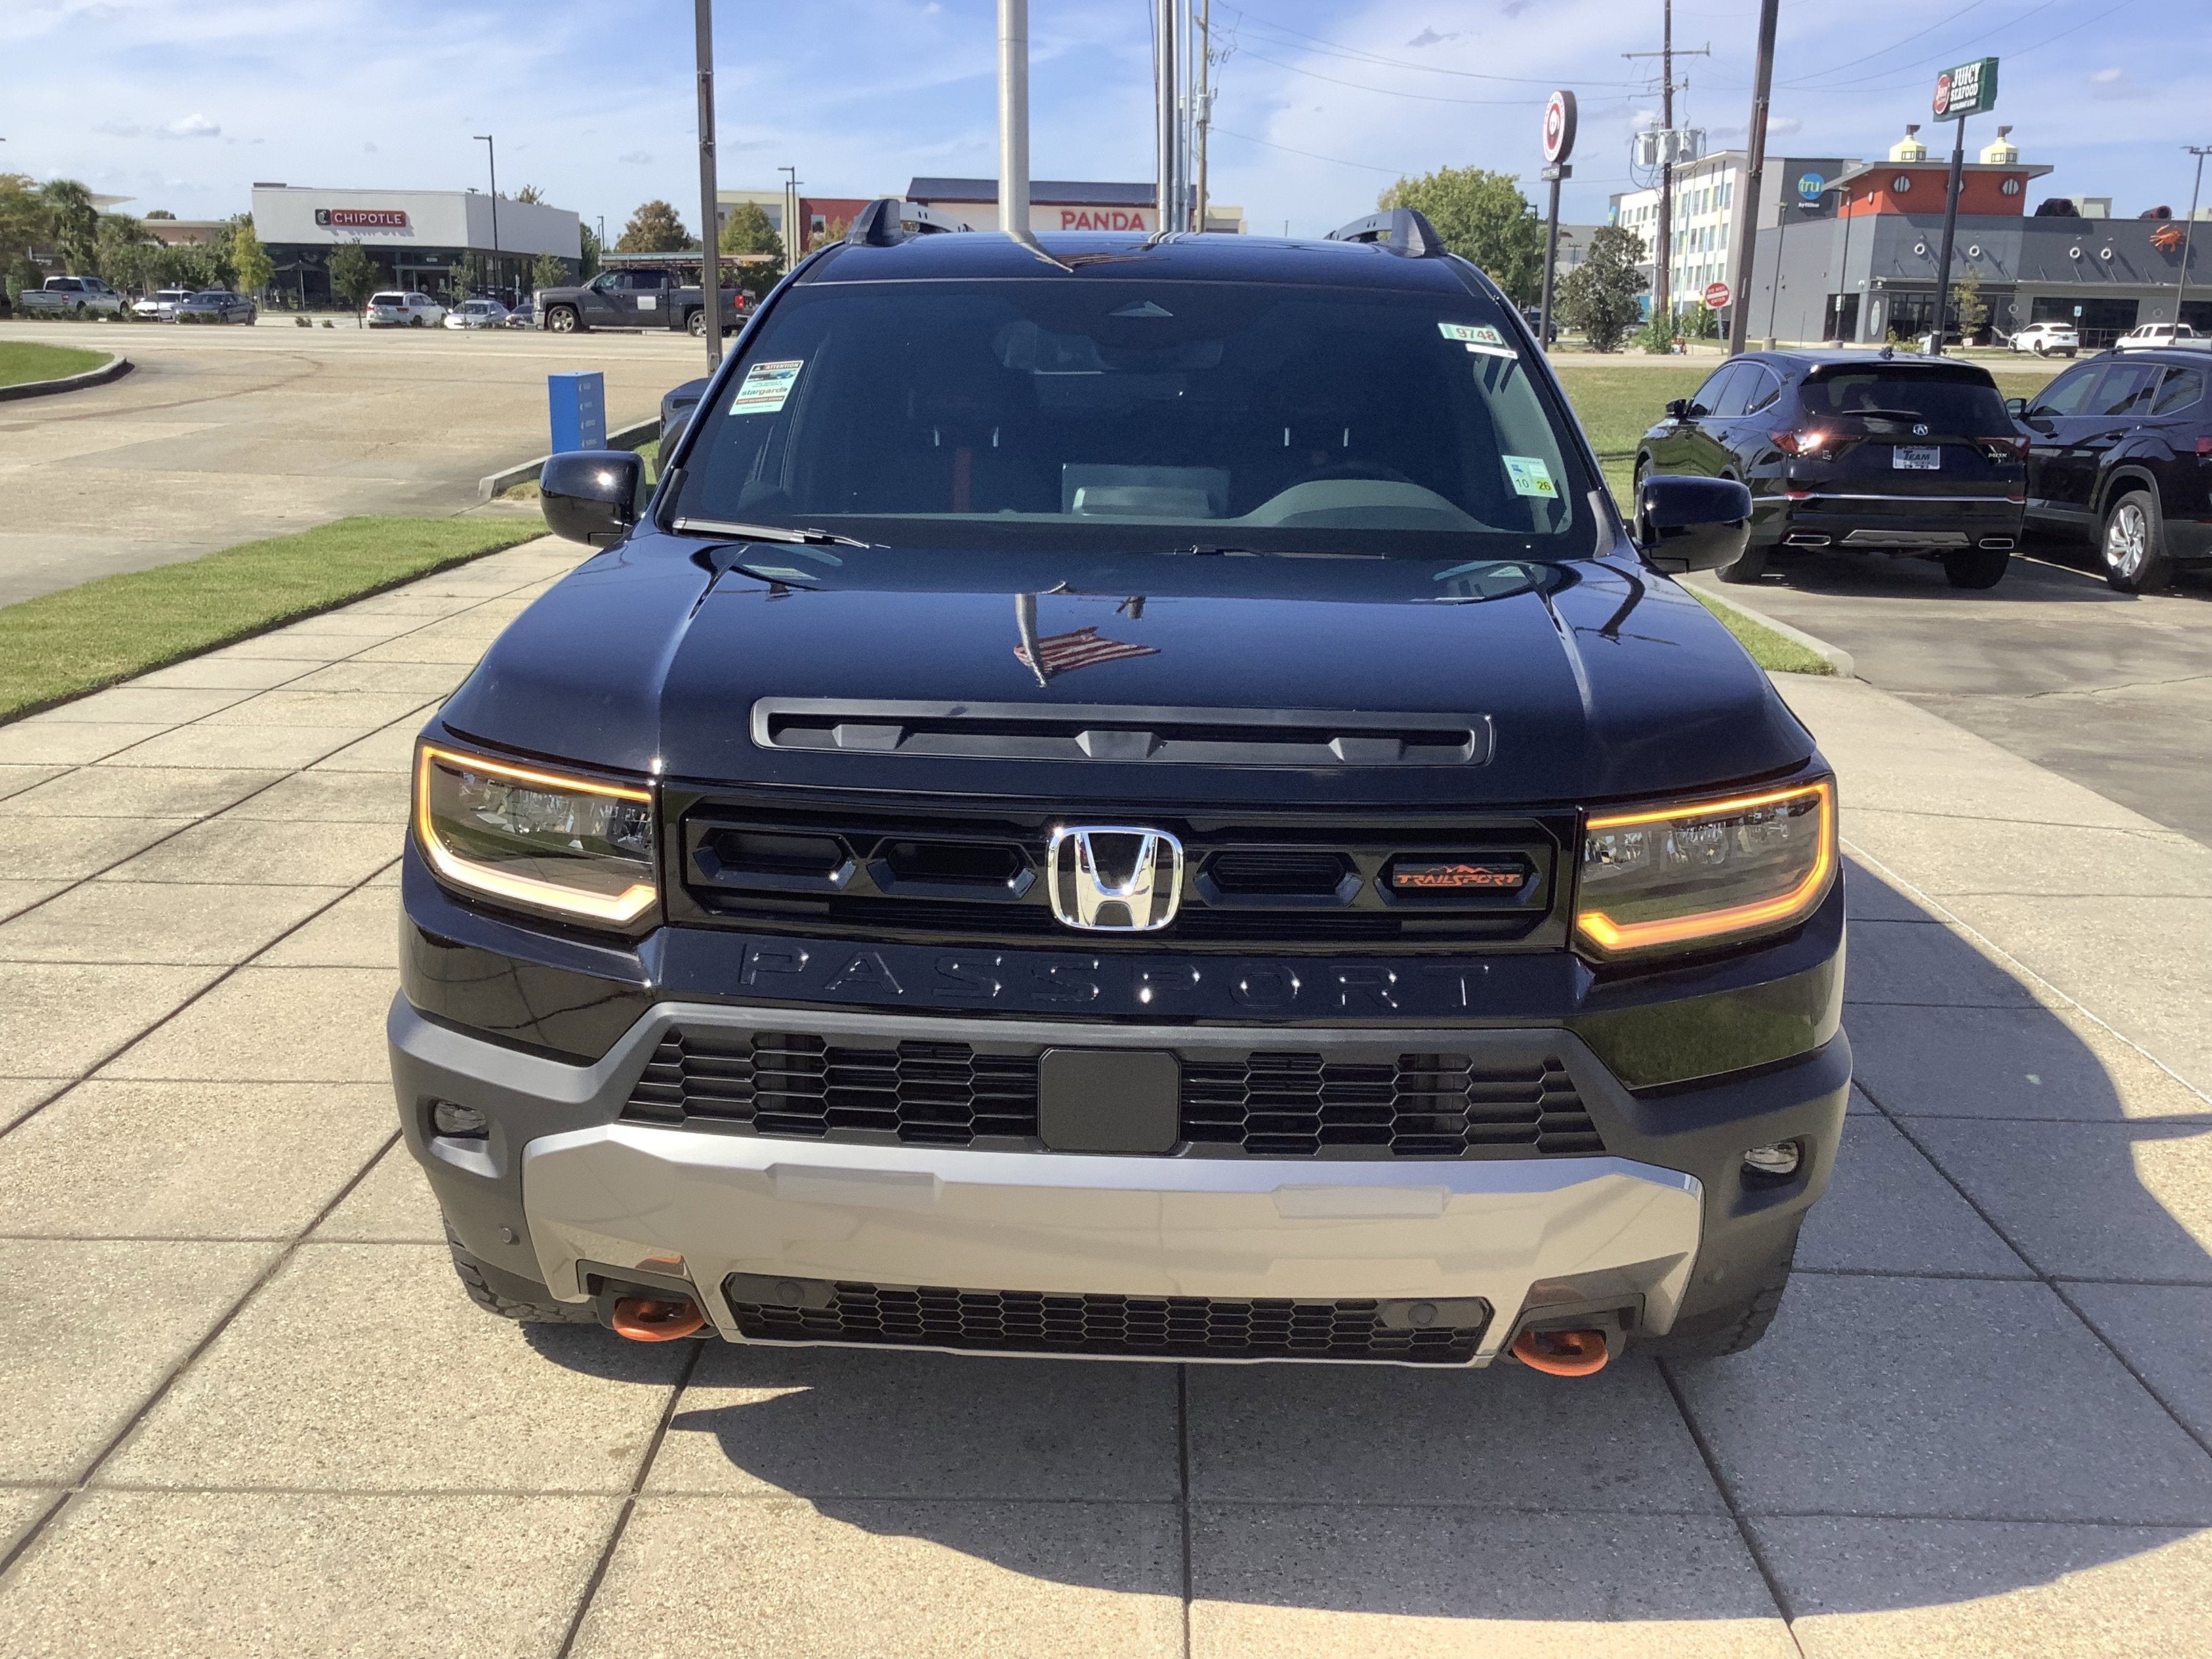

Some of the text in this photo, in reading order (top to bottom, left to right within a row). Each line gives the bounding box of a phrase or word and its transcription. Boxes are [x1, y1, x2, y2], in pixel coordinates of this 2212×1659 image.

[1952, 62, 1981, 88] JUICY
[1950, 82, 1978, 102] SEAFOOD
[1798, 178, 1820, 192] tru
[334, 213, 402, 224] CHIPOTLE
[1061, 210, 1145, 231] PANDA
[1456, 327, 1497, 341] 9748
[1516, 478, 1551, 491] 10 26
[1396, 874, 1521, 887] TRAILSPORT
[737, 941, 1490, 1008] PASSPORT
